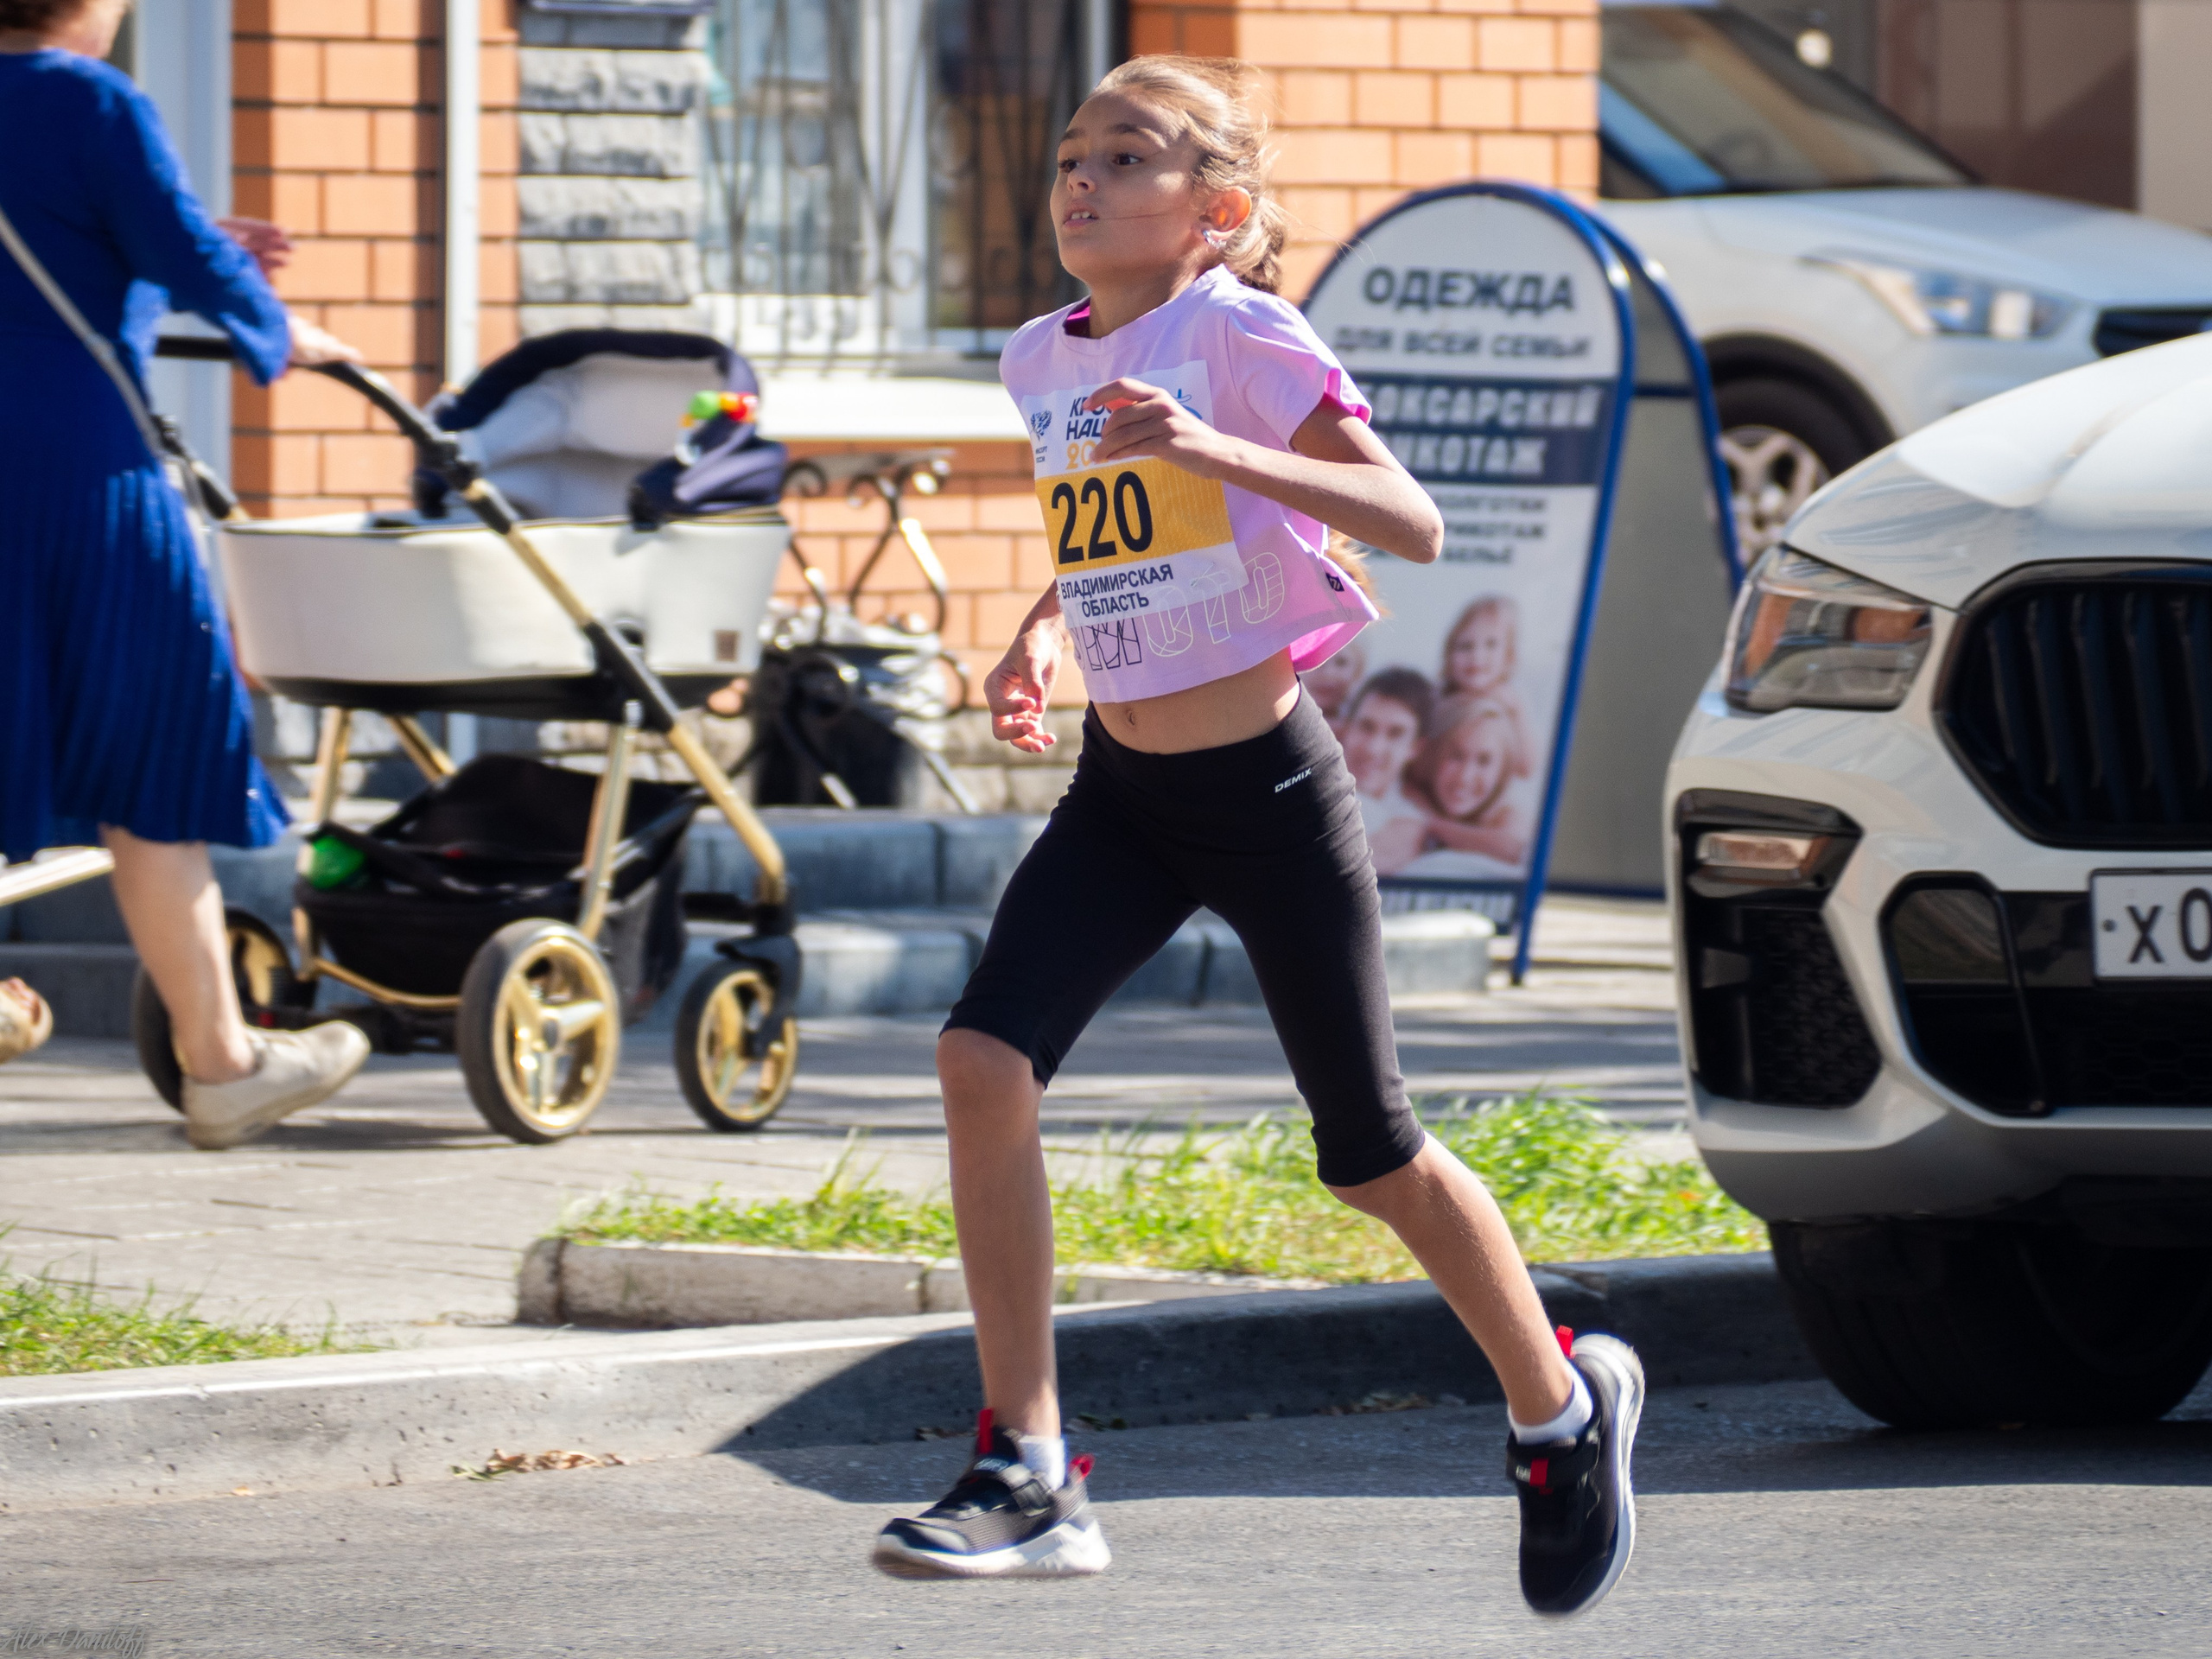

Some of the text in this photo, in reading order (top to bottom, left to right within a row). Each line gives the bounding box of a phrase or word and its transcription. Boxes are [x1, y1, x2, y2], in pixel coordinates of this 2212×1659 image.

[1363, 267, 1576, 315] ОДЕЖДА
[1359, 383, 1601, 428] ОКСАРСКИЙ
[1384, 433, 1547, 474] ИКОТАЖ
[1052, 470, 1153, 565] 220
[1060, 563, 1173, 600] ВЛАДИМИРСКАЯ
[1082, 591, 1149, 618] ОБЛАСТЬ
[1274, 767, 1312, 793] DEMIX
